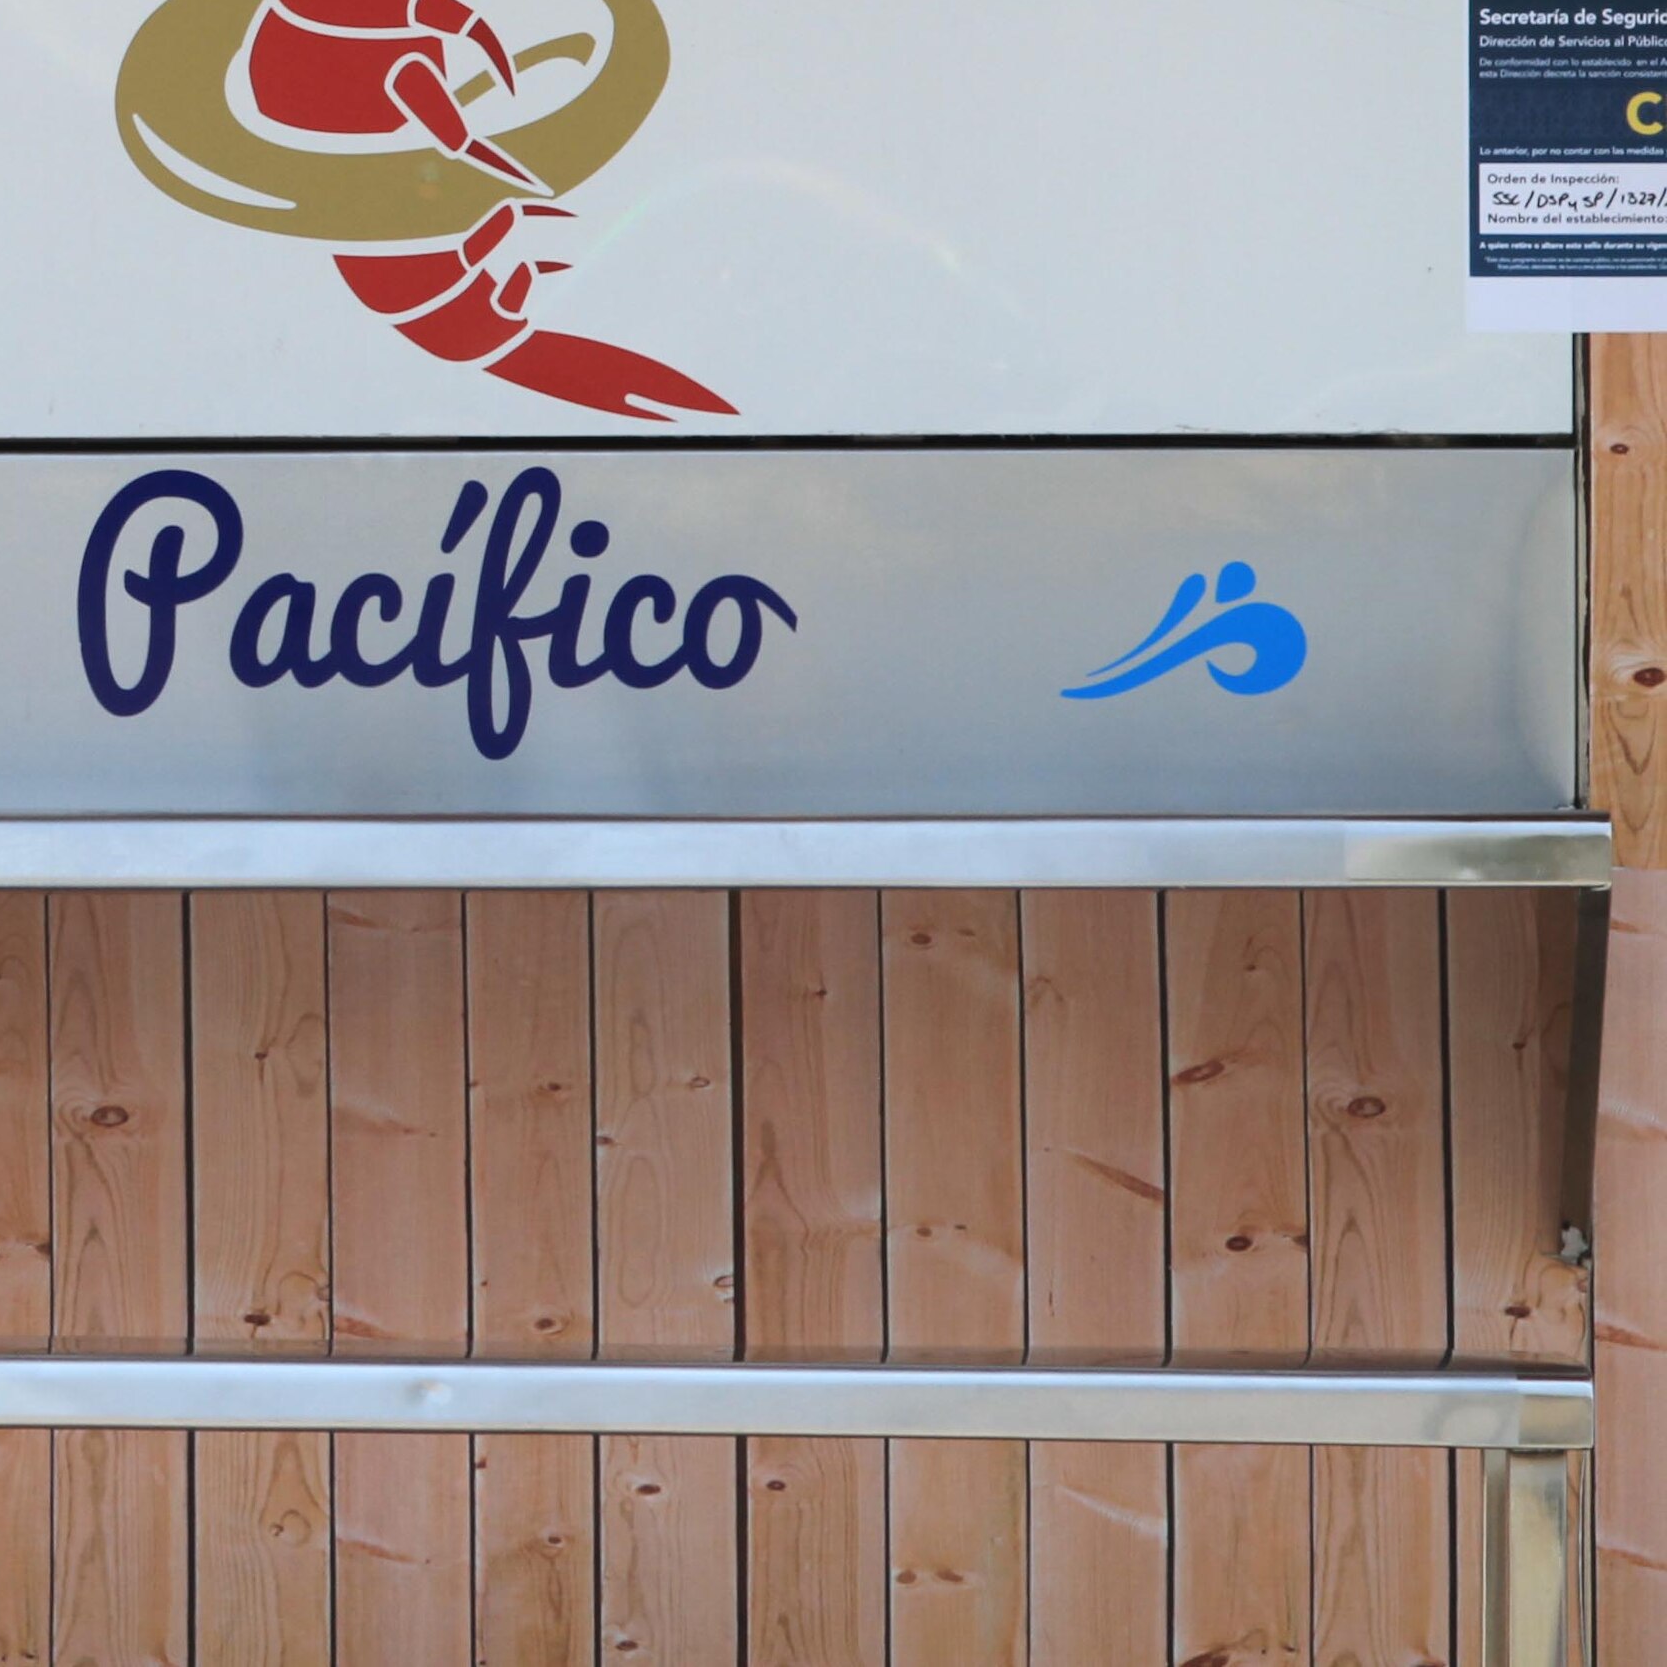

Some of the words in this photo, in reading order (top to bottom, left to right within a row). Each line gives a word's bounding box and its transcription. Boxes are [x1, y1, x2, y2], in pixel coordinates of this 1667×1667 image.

[1480, 8, 1569, 25] Secretaría
[1574, 8, 1597, 25] de
[1479, 35, 1536, 47] Dirección
[1539, 35, 1555, 47] de
[1558, 35, 1611, 47] Servicios
[1614, 35, 1624, 47] al
[1487, 173, 1527, 184] Orden
[1531, 174, 1546, 184] de
[1551, 174, 1619, 185] Inspección:
[1488, 214, 1538, 223] Nombre
[1543, 214, 1562, 223] del
[77, 466, 798, 760] Pacífico
